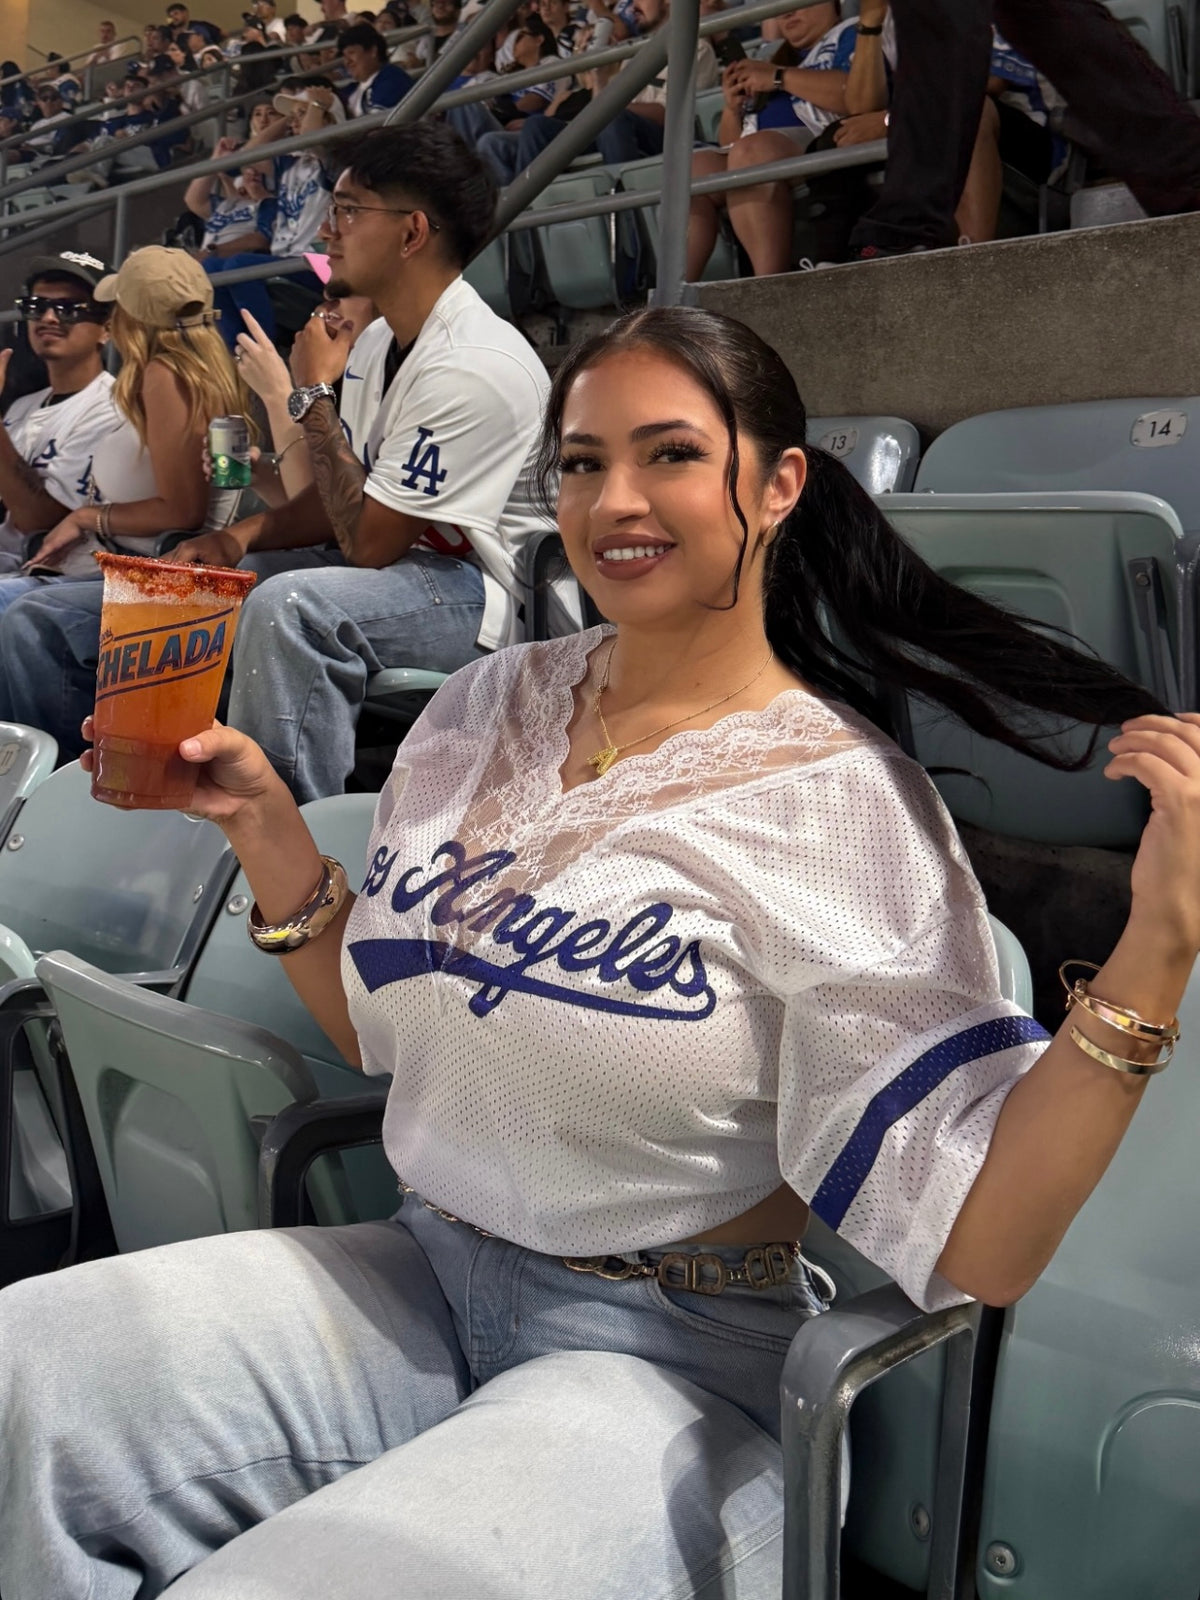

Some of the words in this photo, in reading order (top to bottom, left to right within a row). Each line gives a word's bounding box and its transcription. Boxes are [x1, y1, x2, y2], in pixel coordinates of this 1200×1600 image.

[830, 435, 847, 451] 13
[1150, 419, 1171, 438] 14
[401, 425, 448, 497] LA
[391, 840, 707, 1018] Angeles
